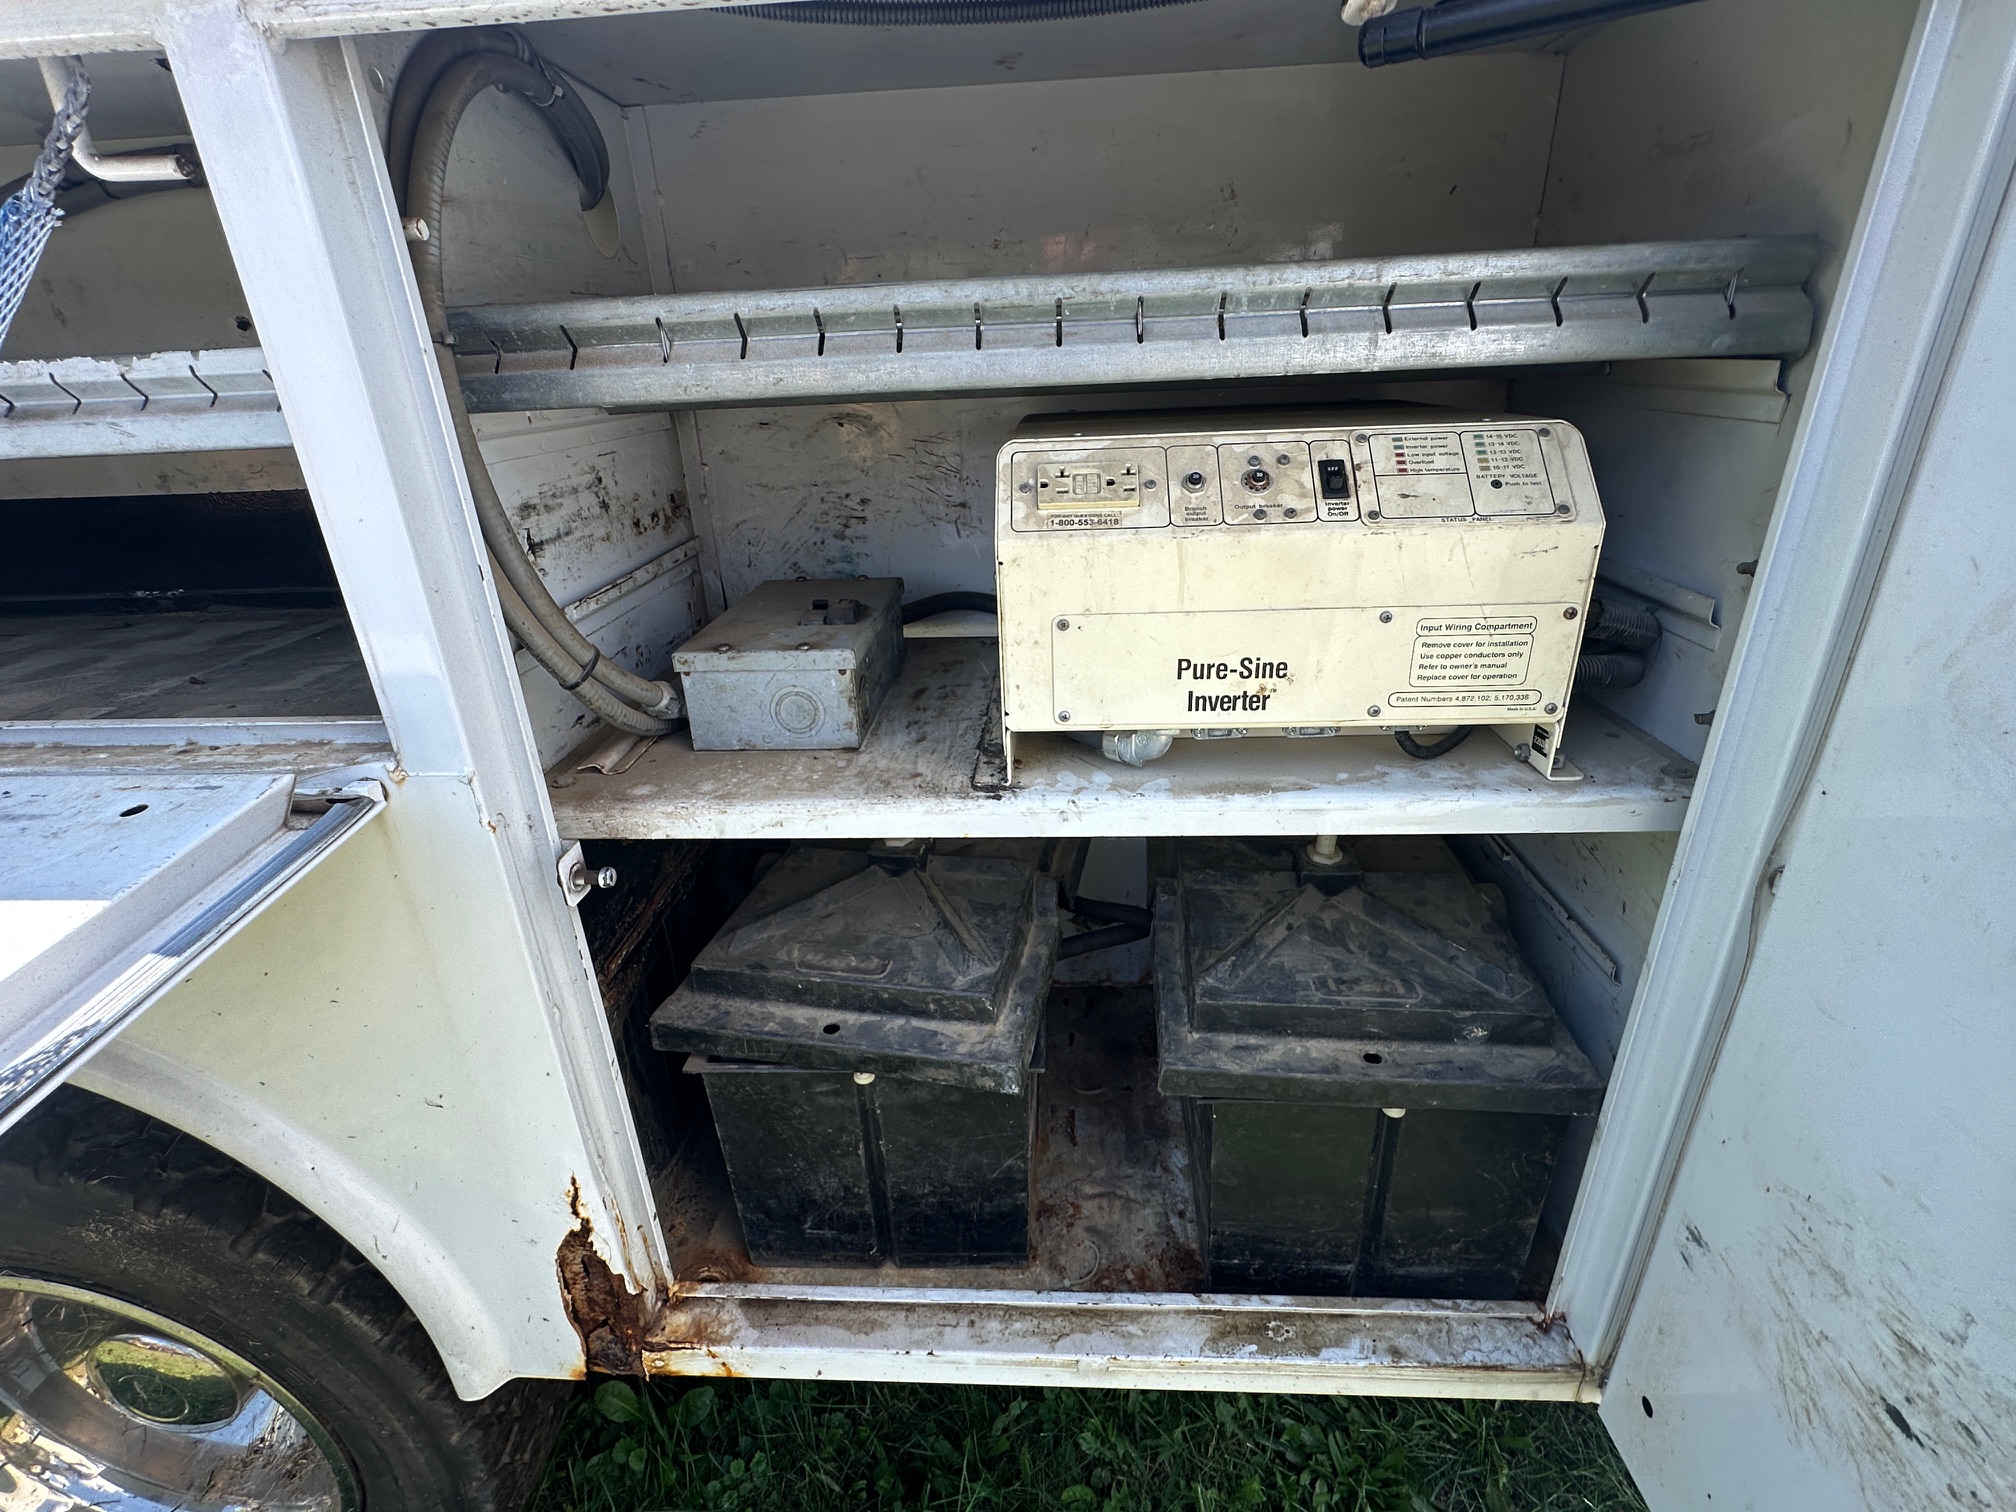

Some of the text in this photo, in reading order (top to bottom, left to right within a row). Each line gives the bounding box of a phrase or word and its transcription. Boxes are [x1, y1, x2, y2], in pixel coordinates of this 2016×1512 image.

[1420, 622, 1533, 633] Input Wiring Compartment
[1507, 651, 1524, 659] only
[1177, 657, 1288, 680] Pure-Sine
[1187, 690, 1271, 712] Inverter
